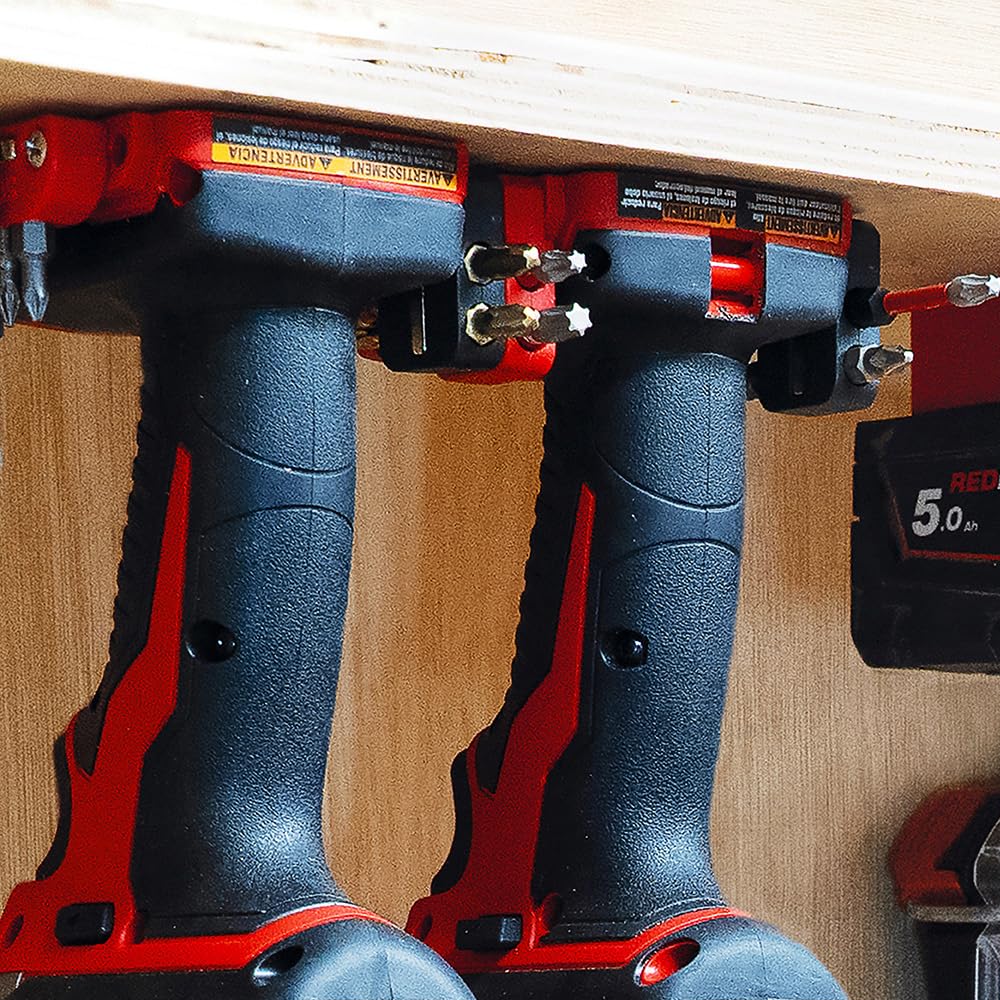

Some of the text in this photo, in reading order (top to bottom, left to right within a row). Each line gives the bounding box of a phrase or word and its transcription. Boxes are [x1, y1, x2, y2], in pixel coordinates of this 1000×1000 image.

[229, 146, 317, 169] ADVERTENCIA
[350, 161, 443, 185] AVERTISSEMENT
[911, 488, 963, 537] 5.0
